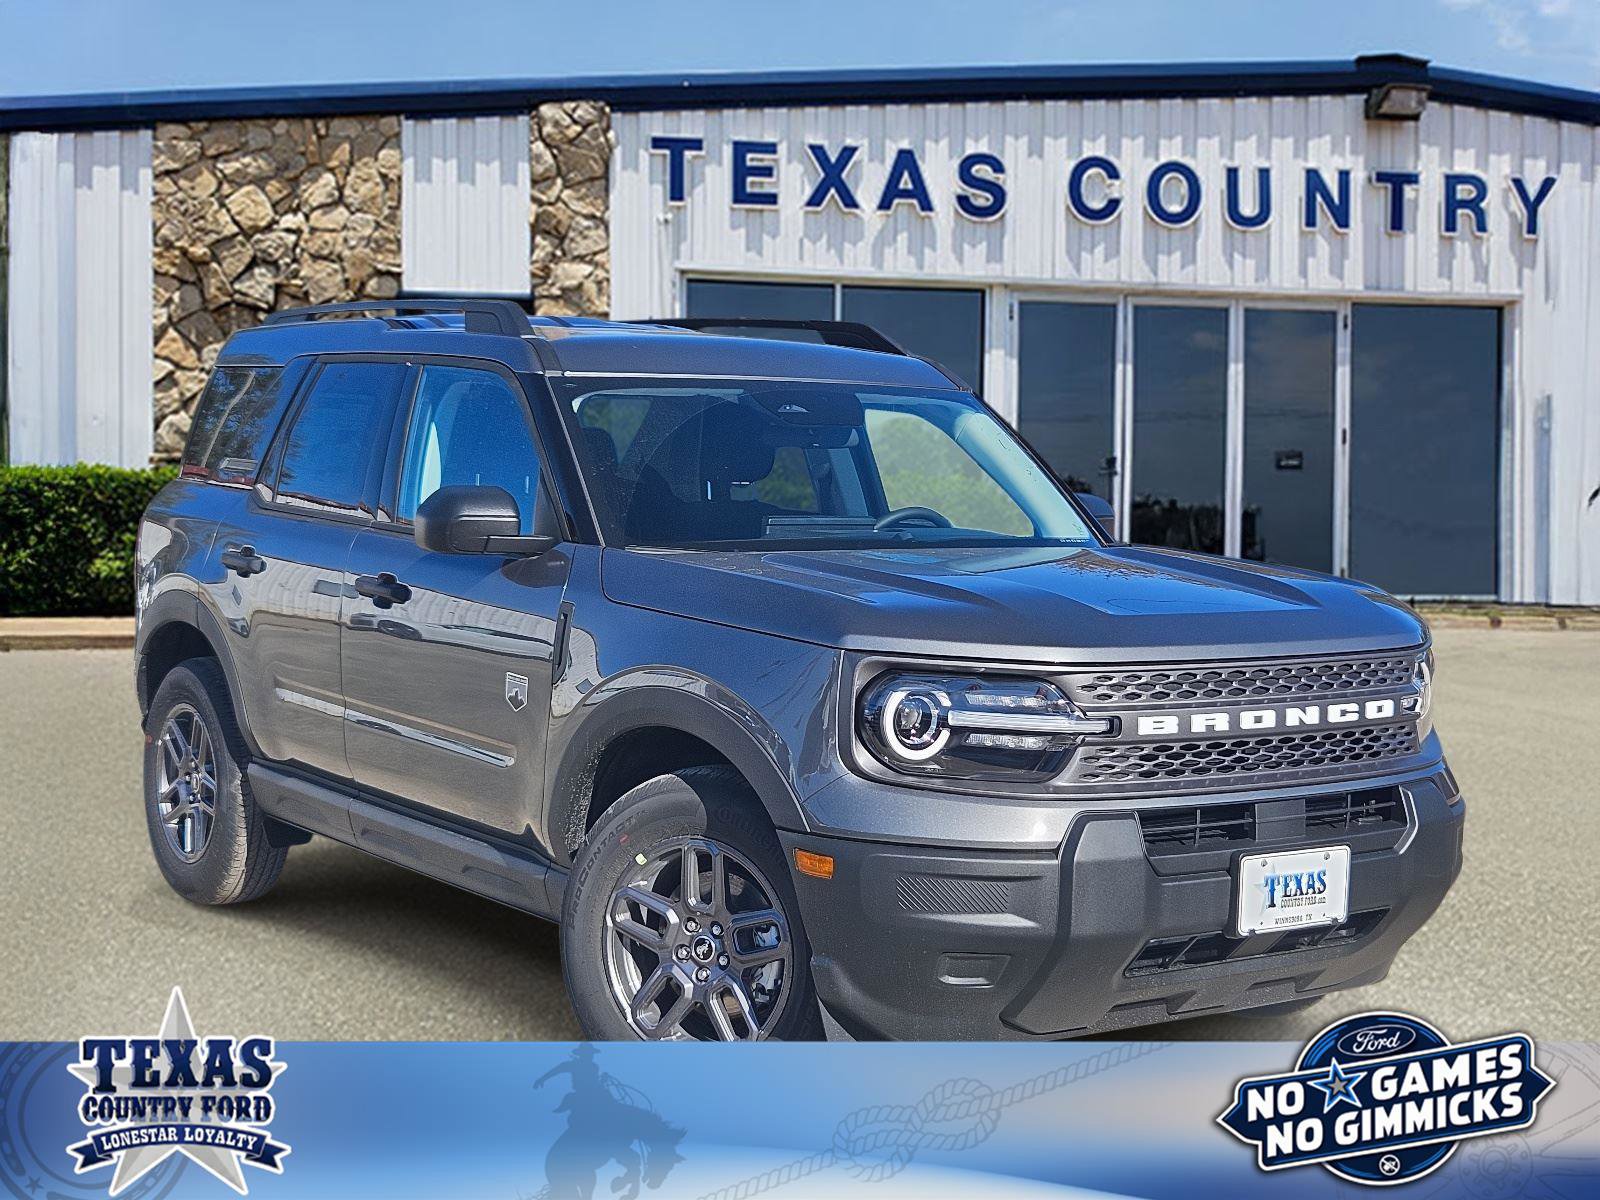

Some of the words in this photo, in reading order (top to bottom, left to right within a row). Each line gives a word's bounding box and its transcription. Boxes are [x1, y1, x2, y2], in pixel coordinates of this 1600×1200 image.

[650, 136, 1007, 219] TEXAS
[1068, 155, 1556, 240] COUNTRY
[1137, 699, 1395, 736] BRONCO
[1264, 870, 1326, 908] TEXAS
